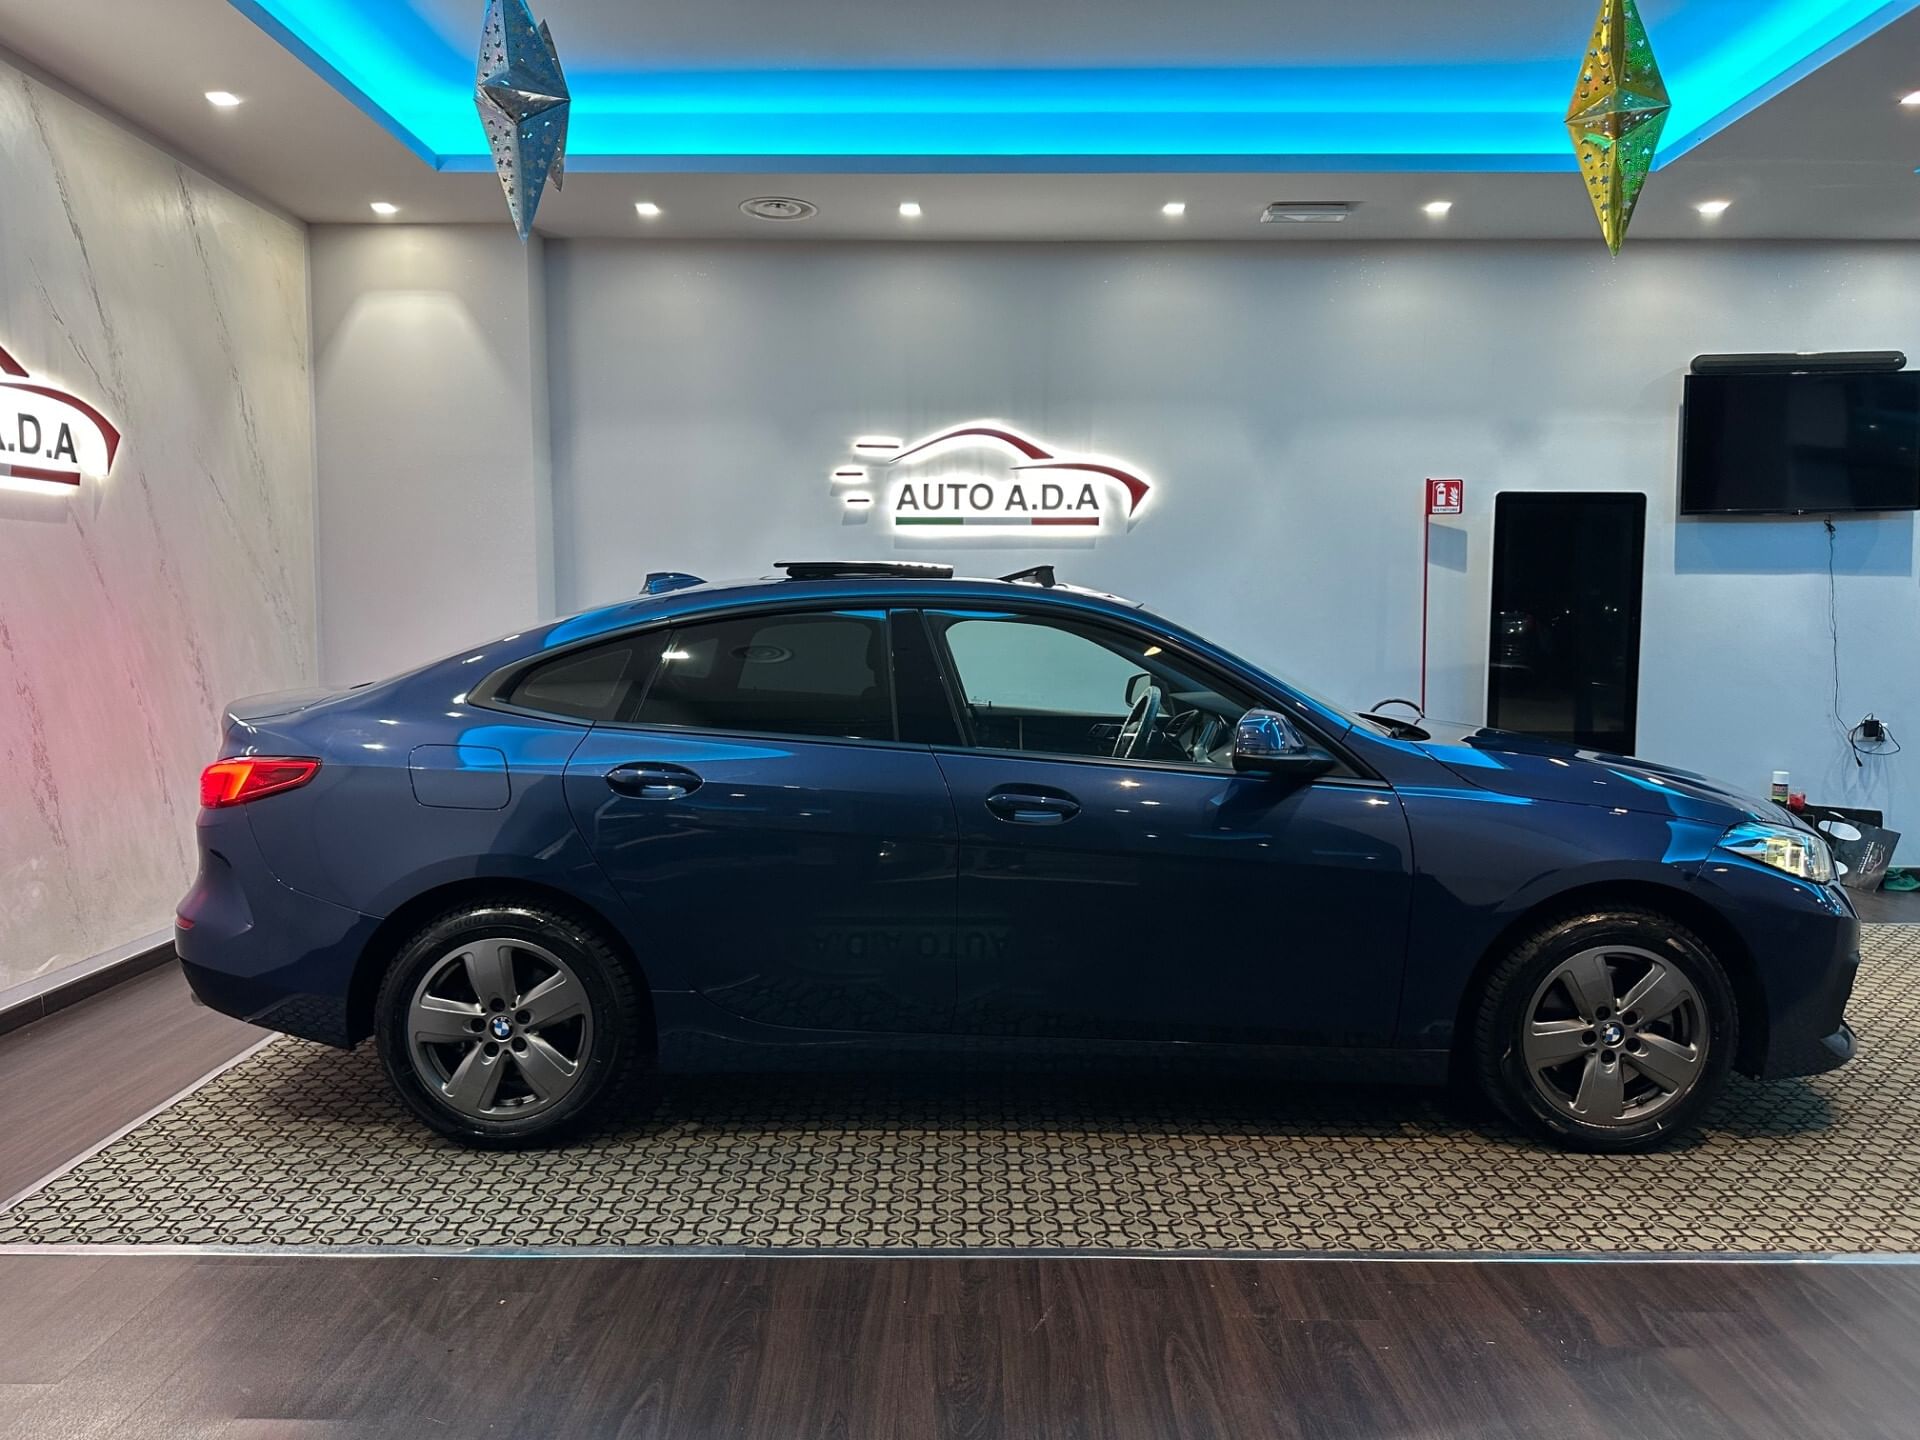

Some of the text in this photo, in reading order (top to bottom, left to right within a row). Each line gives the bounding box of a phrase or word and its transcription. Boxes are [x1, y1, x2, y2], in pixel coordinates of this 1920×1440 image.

[0, 413, 78, 463] .D.A
[896, 483, 1100, 511] AUTO A.D.A
